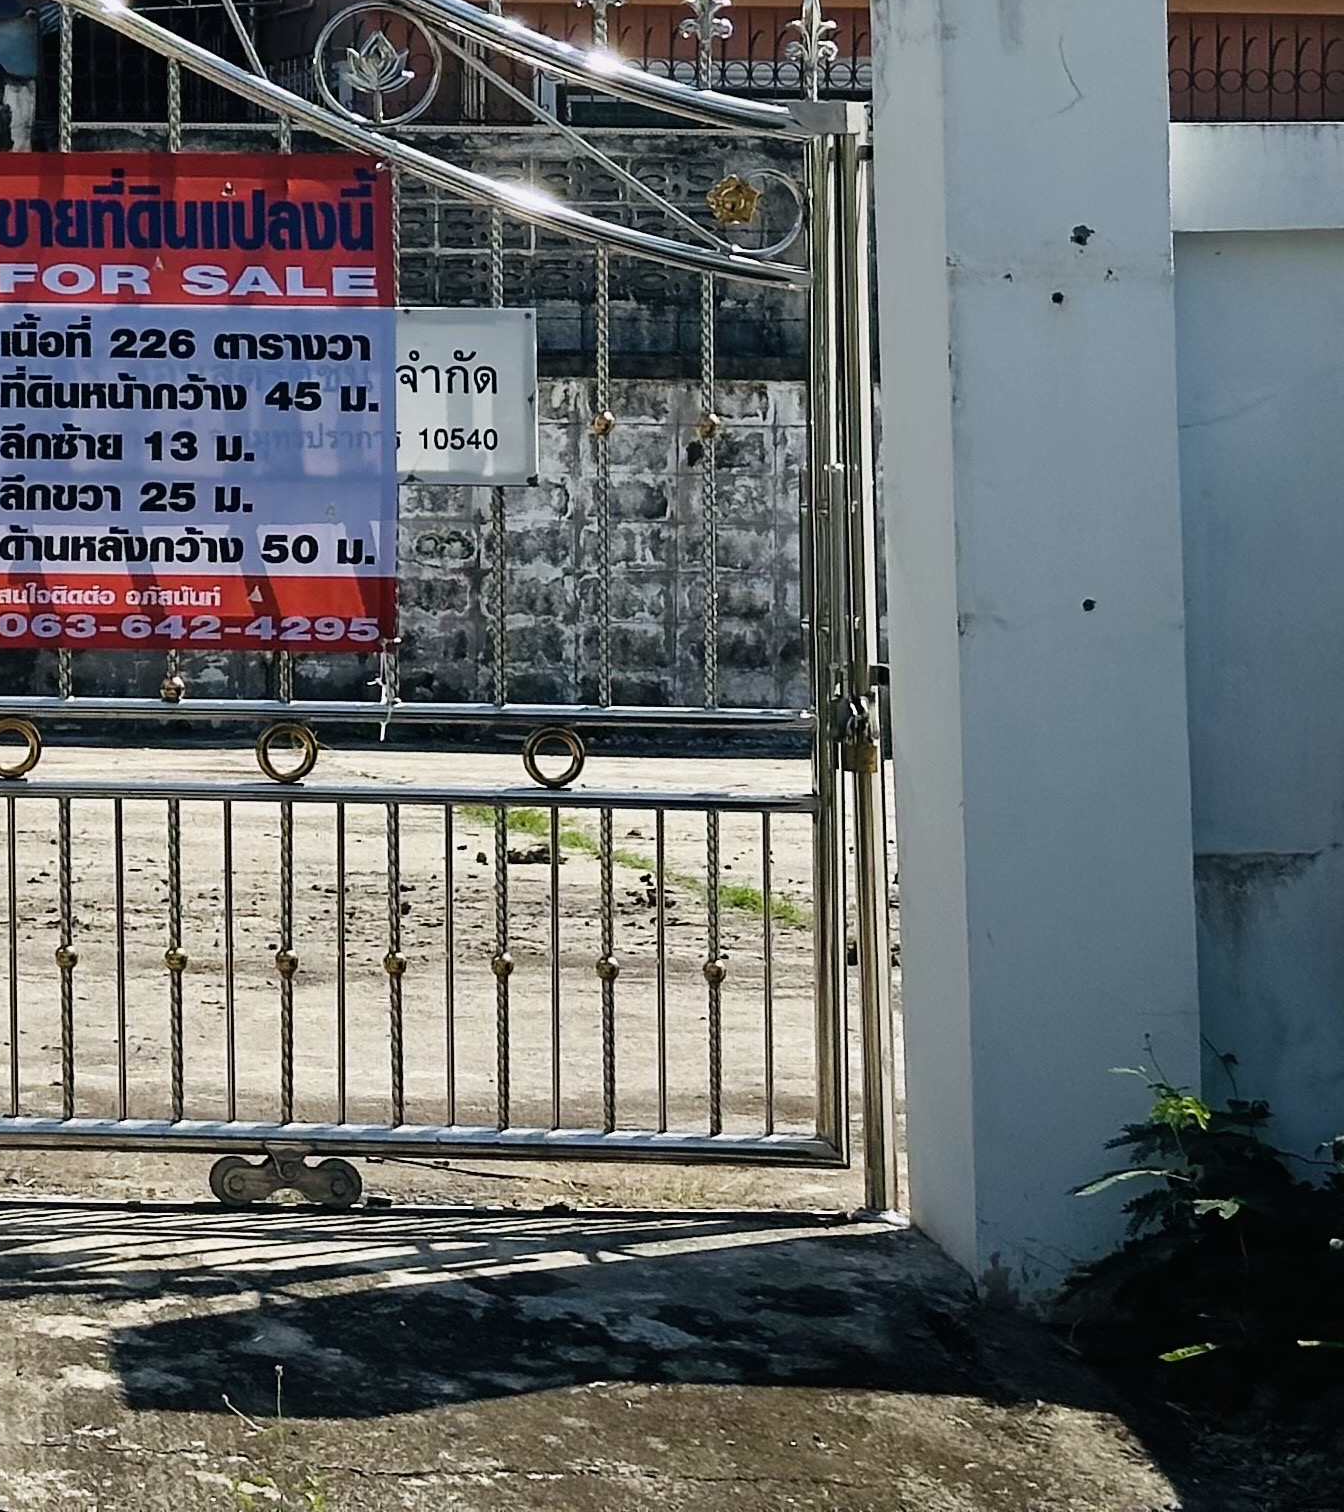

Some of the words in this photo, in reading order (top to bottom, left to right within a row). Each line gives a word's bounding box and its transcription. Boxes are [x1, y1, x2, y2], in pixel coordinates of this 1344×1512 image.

[181, 265, 379, 297] SALE
[0, 314, 92, 359] เนื้อที่
[109, 328, 196, 360] 226
[214, 333, 371, 362] ตารางวา
[0, 366, 246, 411] ที่ดินหน้ากว้าง
[265, 381, 321, 412] 45
[340, 383, 380, 412] ม.
[396, 350, 498, 394] จำกัด
[0, 422, 123, 462] ลึกซ้าย
[144, 431, 198, 462] 13
[215, 434, 255, 462] ม.
[418, 428, 499, 451] 10540
[0, 474, 122, 512] ลึกขวา
[139, 481, 197, 513] 25
[214, 485, 254, 513] ม.
[0, 526, 244, 563] ด้านหลังกว้าง
[261, 534, 319, 564] 50
[337, 538, 376, 565] ม.
[125, 585, 221, 607] อภัสนันท์
